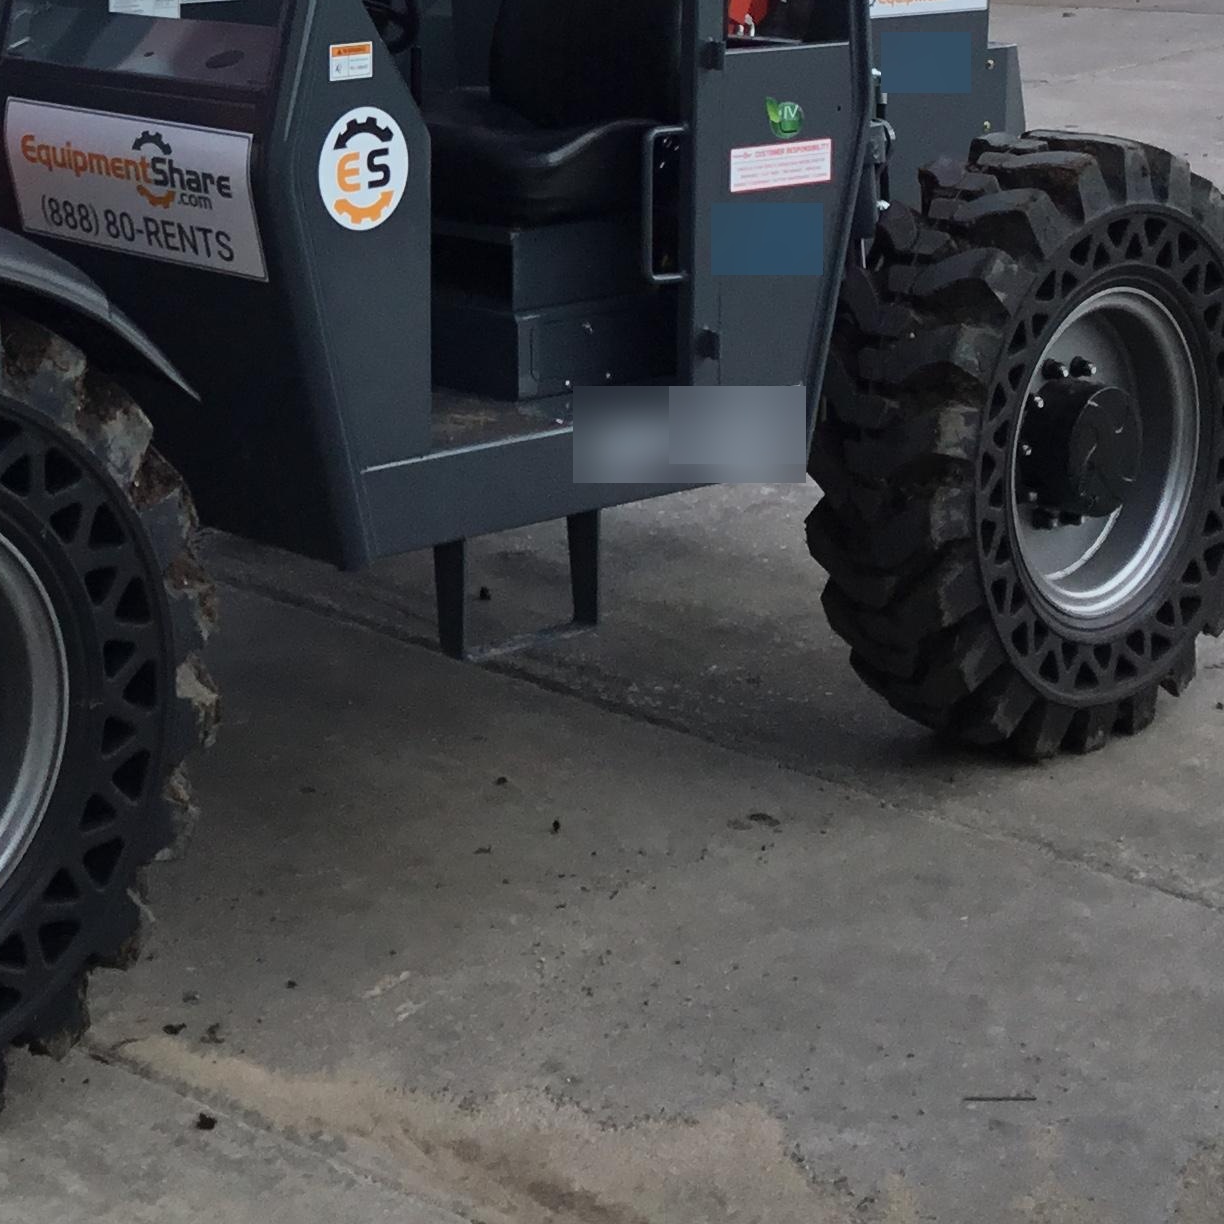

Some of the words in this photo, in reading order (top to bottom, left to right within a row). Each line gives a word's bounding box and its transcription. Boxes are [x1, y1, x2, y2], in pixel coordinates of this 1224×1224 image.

[21, 134, 233, 199] EquipmentShare
[337, 147, 391, 193] ES
[41, 194, 99, 237] (888)
[104, 209, 235, 262] 80-RENTS
[178, 193, 213, 210] .com
